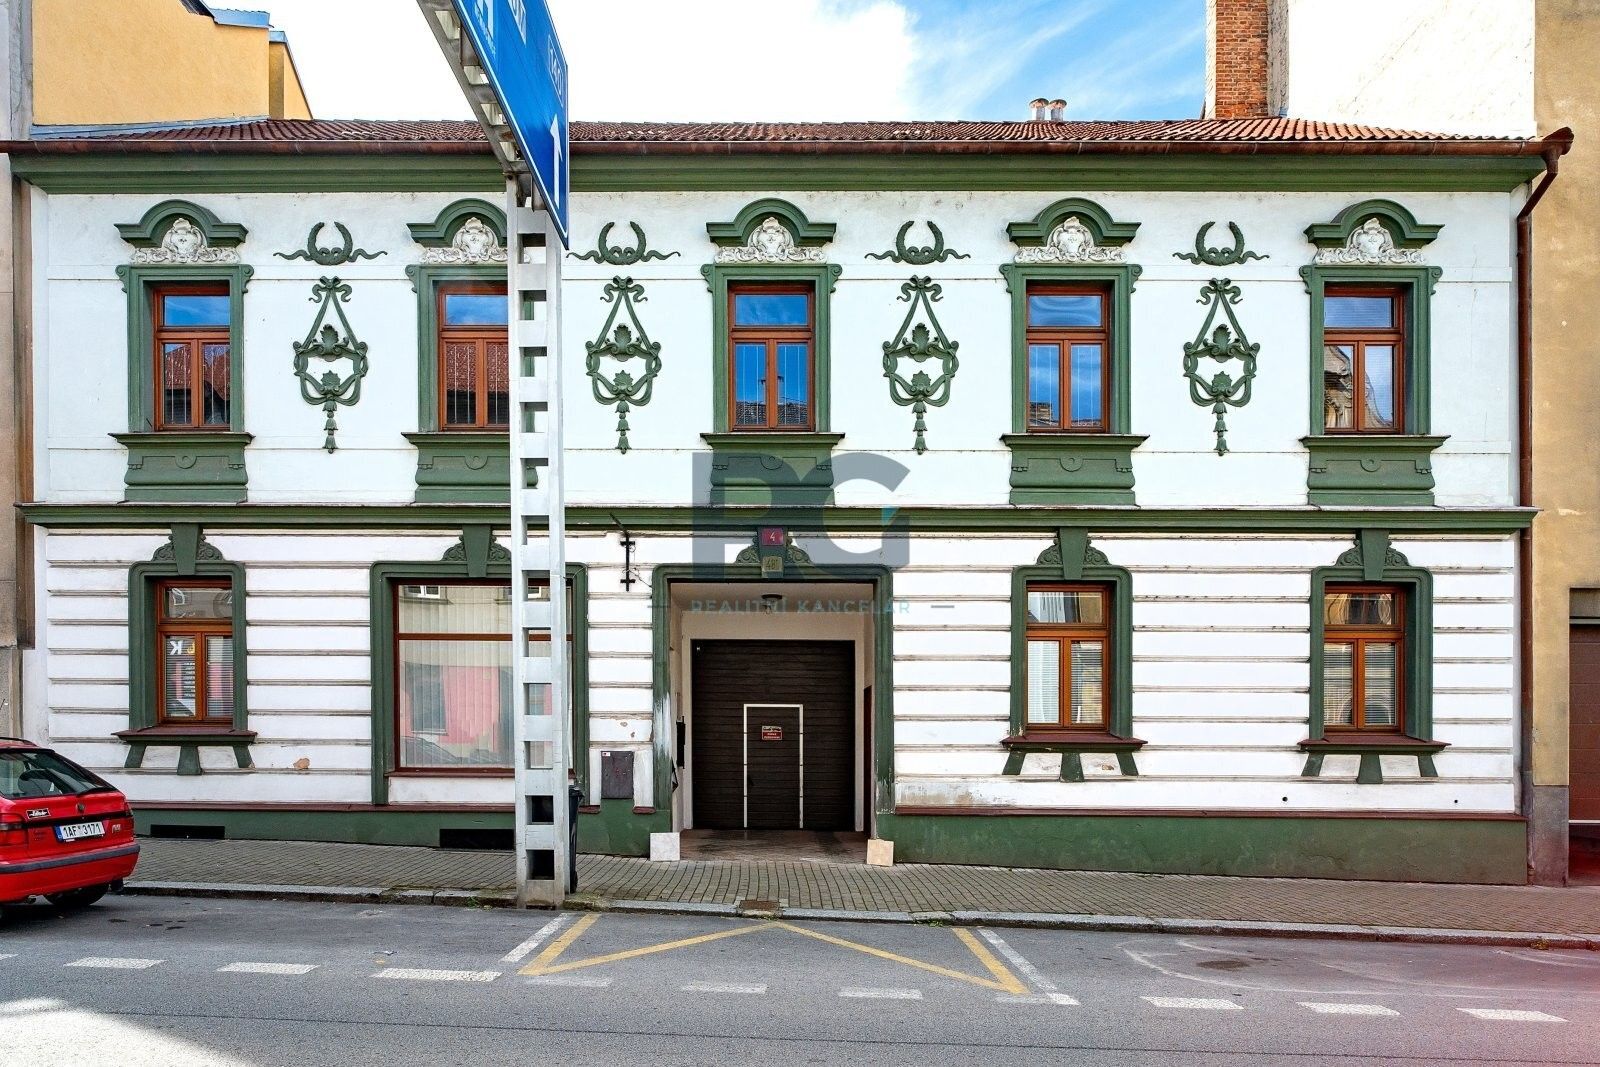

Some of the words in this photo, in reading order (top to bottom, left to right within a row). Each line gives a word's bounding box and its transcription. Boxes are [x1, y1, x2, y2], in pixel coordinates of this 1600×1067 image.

[770, 531, 776, 542] 4
[63, 825, 77, 838] 1AF
[82, 823, 102, 835] 3171
